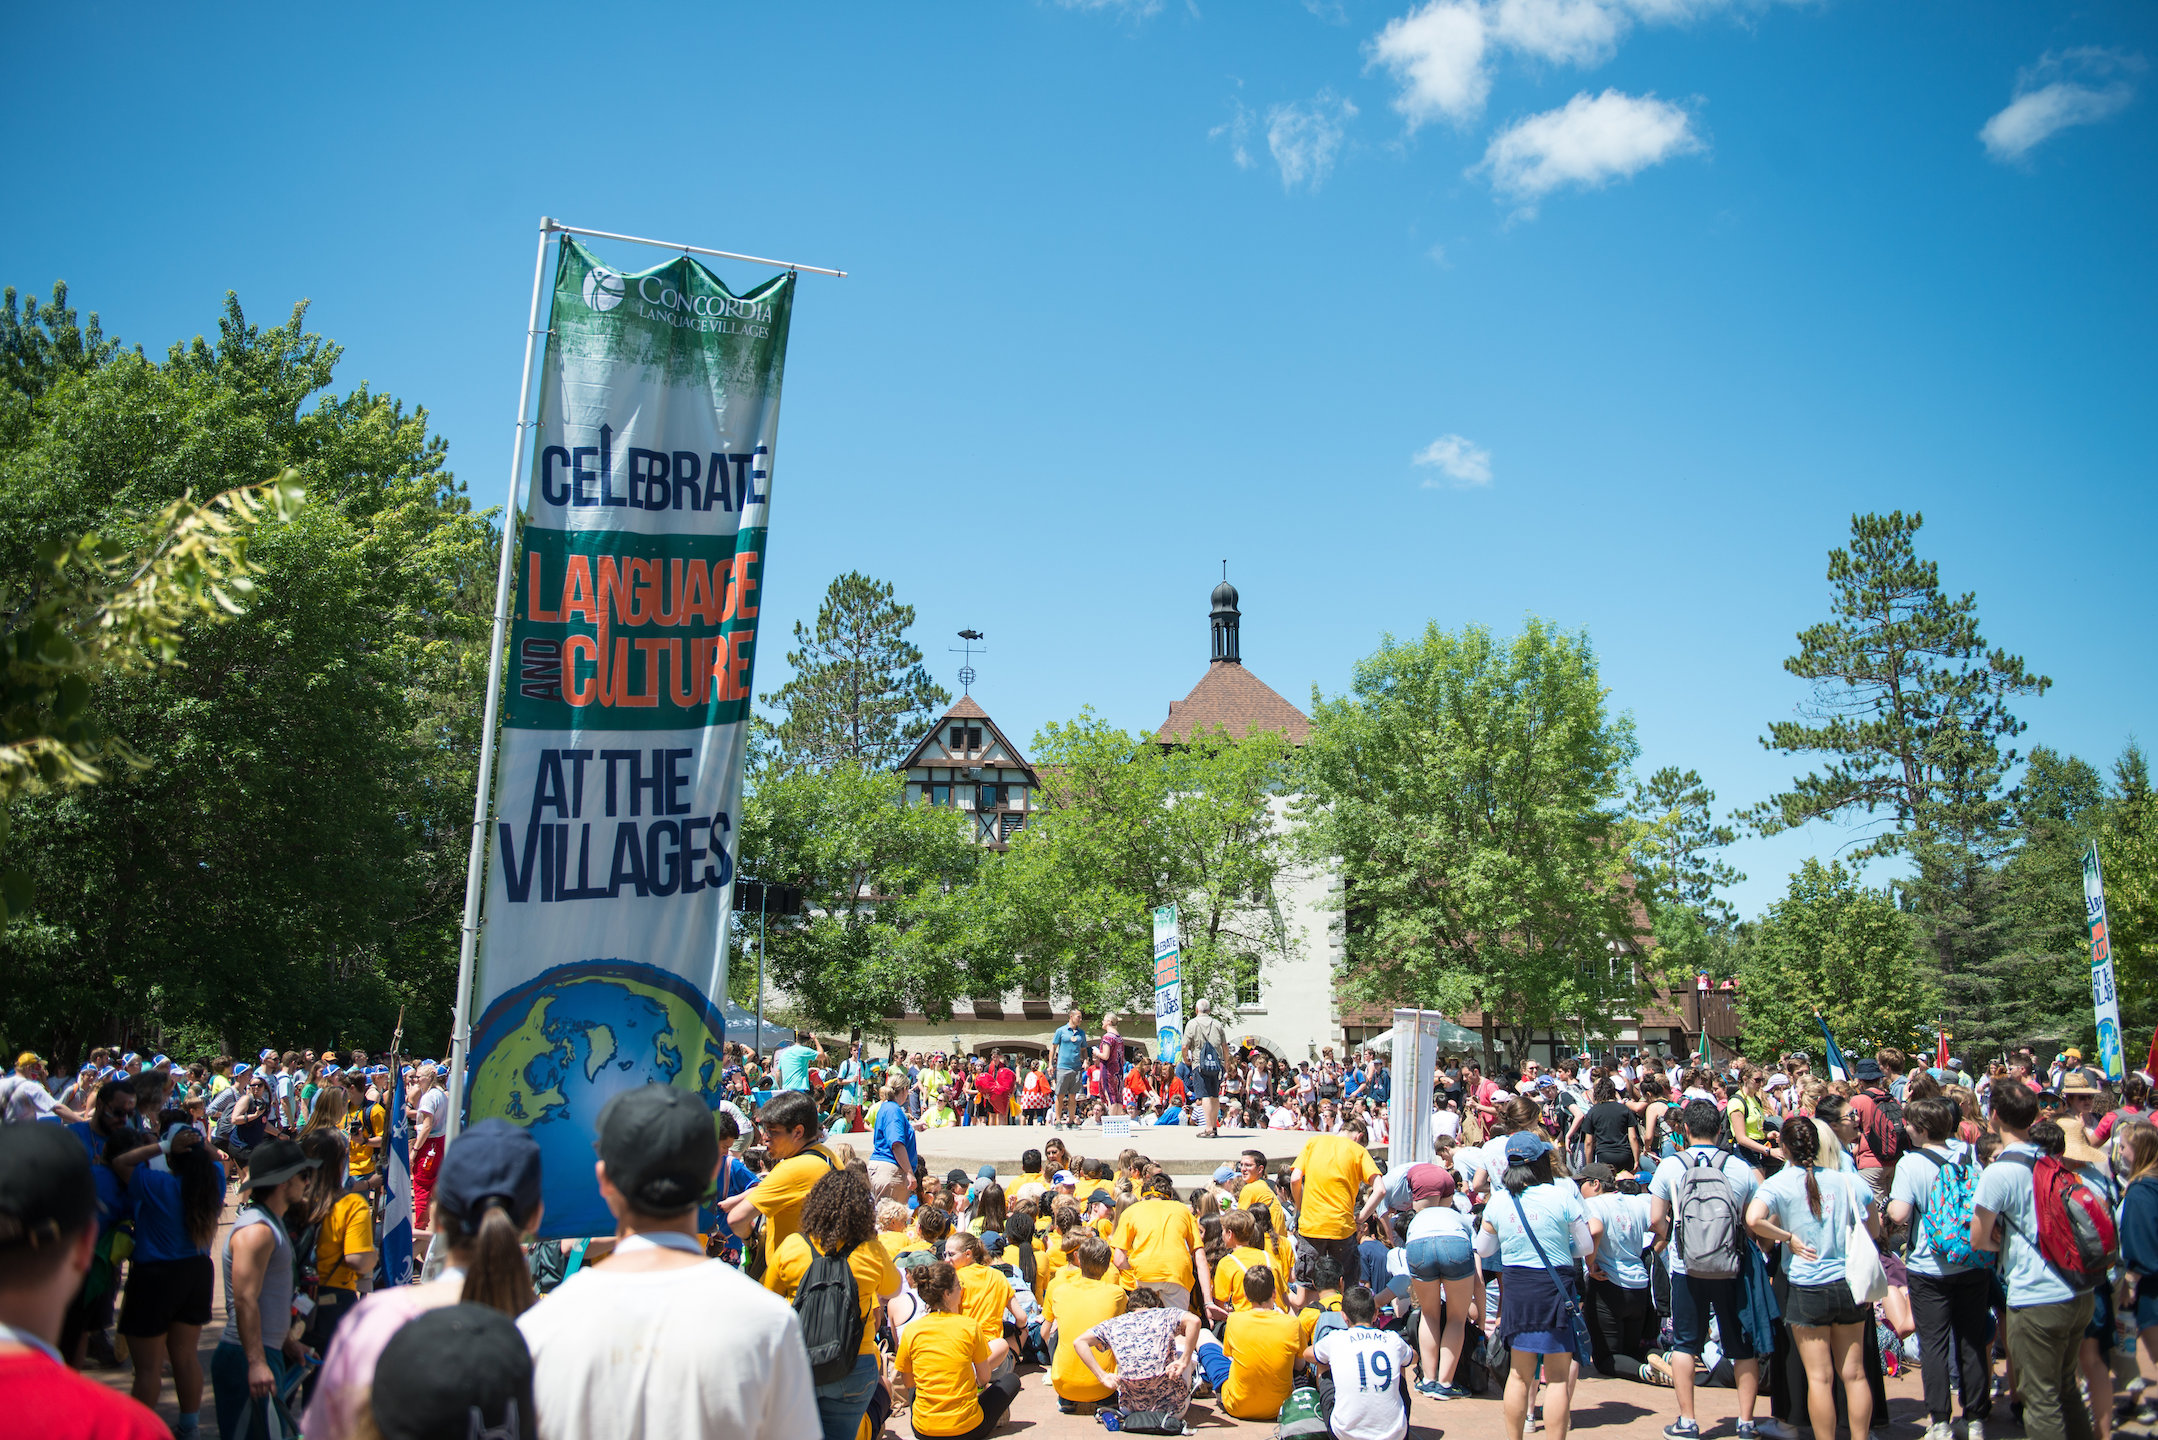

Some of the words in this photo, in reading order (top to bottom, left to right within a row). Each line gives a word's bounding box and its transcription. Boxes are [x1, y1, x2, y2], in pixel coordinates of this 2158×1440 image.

[638, 275, 773, 324] CONCORDIA
[639, 304, 708, 333] LANGUAGE
[708, 318, 770, 340] VILLAGES
[541, 424, 768, 513] CELEBRATE
[528, 551, 759, 626] LANGUAGE
[520, 637, 562, 702] AND
[561, 629, 755, 709] CULTURE
[533, 748, 594, 819] AT
[600, 748, 693, 817] THE
[499, 812, 733, 903] VILLAGES
[1349, 1332, 1388, 1344] ADAMS
[1356, 1350, 1392, 1393] 19
